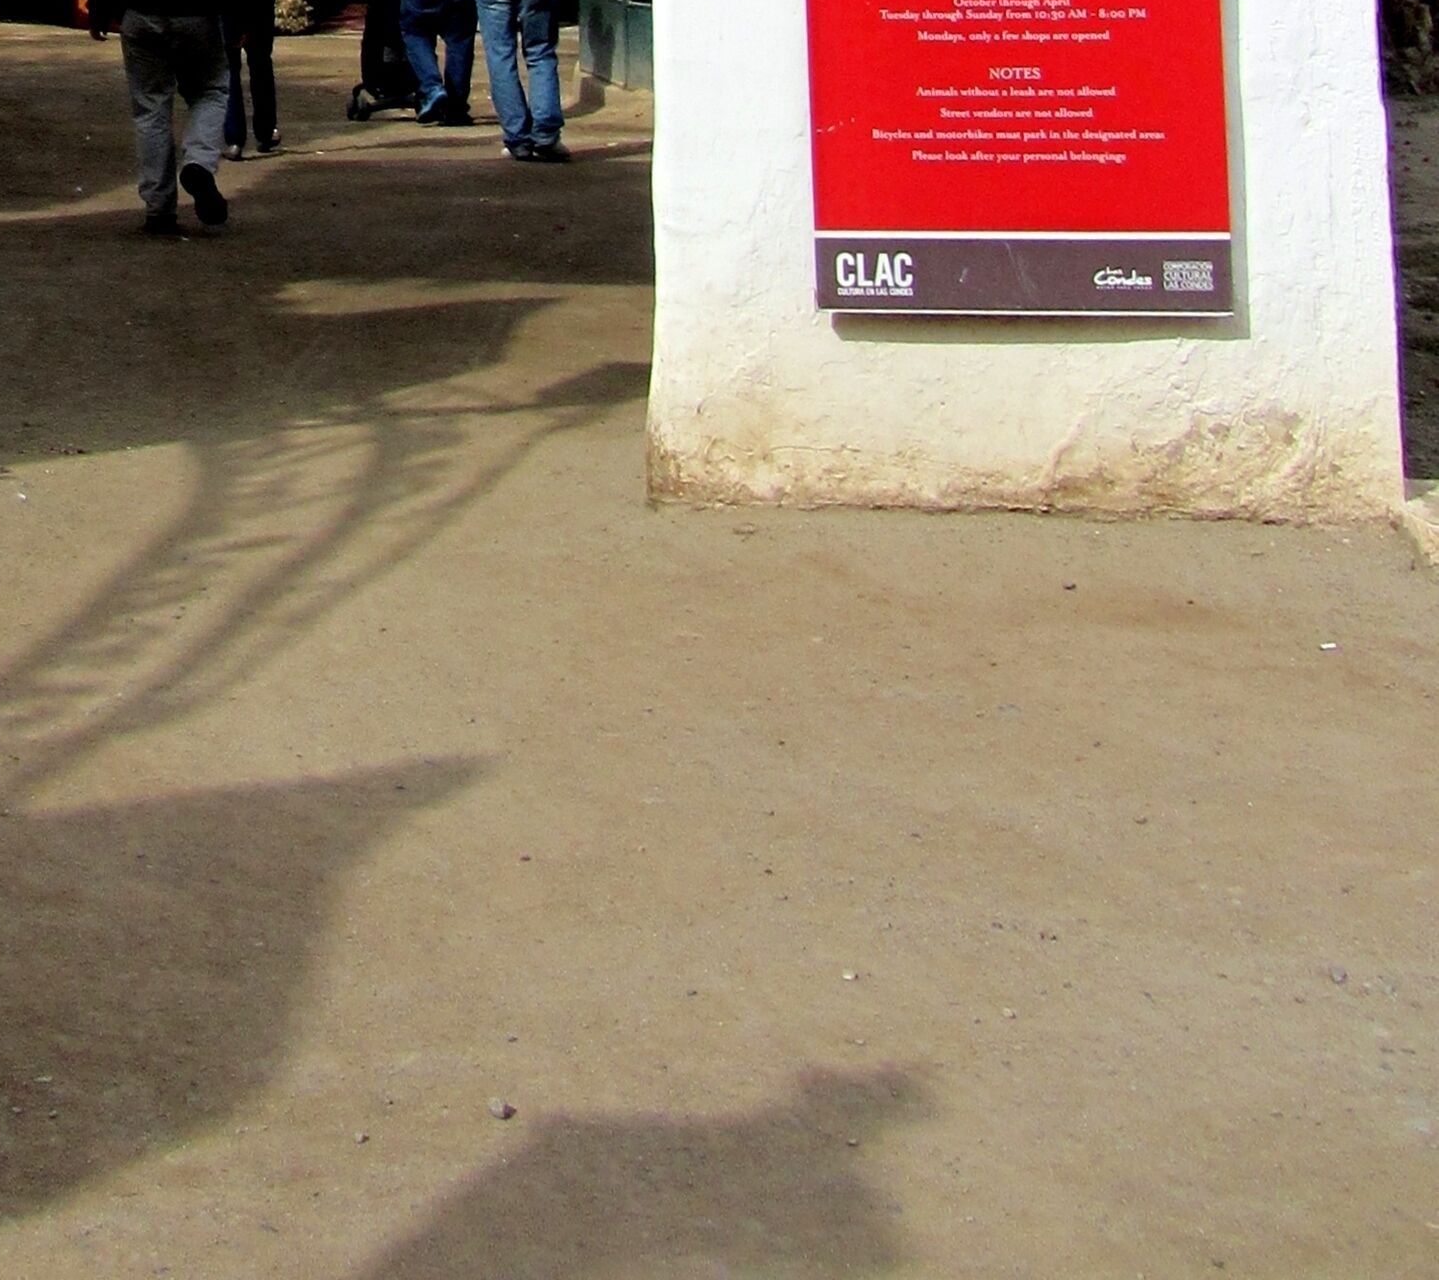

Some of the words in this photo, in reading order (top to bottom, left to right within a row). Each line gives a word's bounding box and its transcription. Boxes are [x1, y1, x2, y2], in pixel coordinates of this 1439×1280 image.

[879, 9, 921, 22] Tuesday
[921, 9, 964, 22] through
[965, 9, 1004, 22] Sunday
[1005, 6, 1033, 20] from
[1067, 8, 1087, 19] AM
[1128, 8, 1147, 18] PM
[968, 30, 992, 44] only
[1001, 30, 1020, 41] few
[1021, 30, 1051, 43] shops
[1052, 33, 1070, 41] are
[1070, 30, 1111, 43] opened
[988, 67, 1042, 80] NOTES
[916, 86, 959, 97] Animals
[959, 86, 1000, 97] without
[1009, 86, 1036, 97] leash
[1037, 89, 1055, 97] are
[1056, 88, 1075, 97] not
[1076, 85, 1117, 97] allowed
[939, 107, 971, 118] Street
[972, 107, 1014, 118] vendors
[1014, 110, 1032, 118] are
[1033, 110, 1053, 118] not
[1054, 107, 1094, 118] allowed
[872, 128, 913, 142] Bicycles
[913, 129, 934, 140] and
[995, 131, 1022, 140] must
[1023, 129, 1048, 143] park
[1049, 130, 1061, 139] in
[1062, 129, 1080, 140] the
[1081, 128, 1137, 142] designated
[1138, 132, 1166, 140] areas
[911, 149, 944, 161] Please
[944, 150, 969, 161] look
[970, 150, 995, 161] after
[996, 153, 1022, 164] your
[1022, 150, 1068, 164] personal
[1069, 150, 1127, 164] belongings
[836, 252, 913, 287] CLAC
[1163, 270, 1213, 280] CULTURAL
[1093, 269, 1153, 286] Condes
